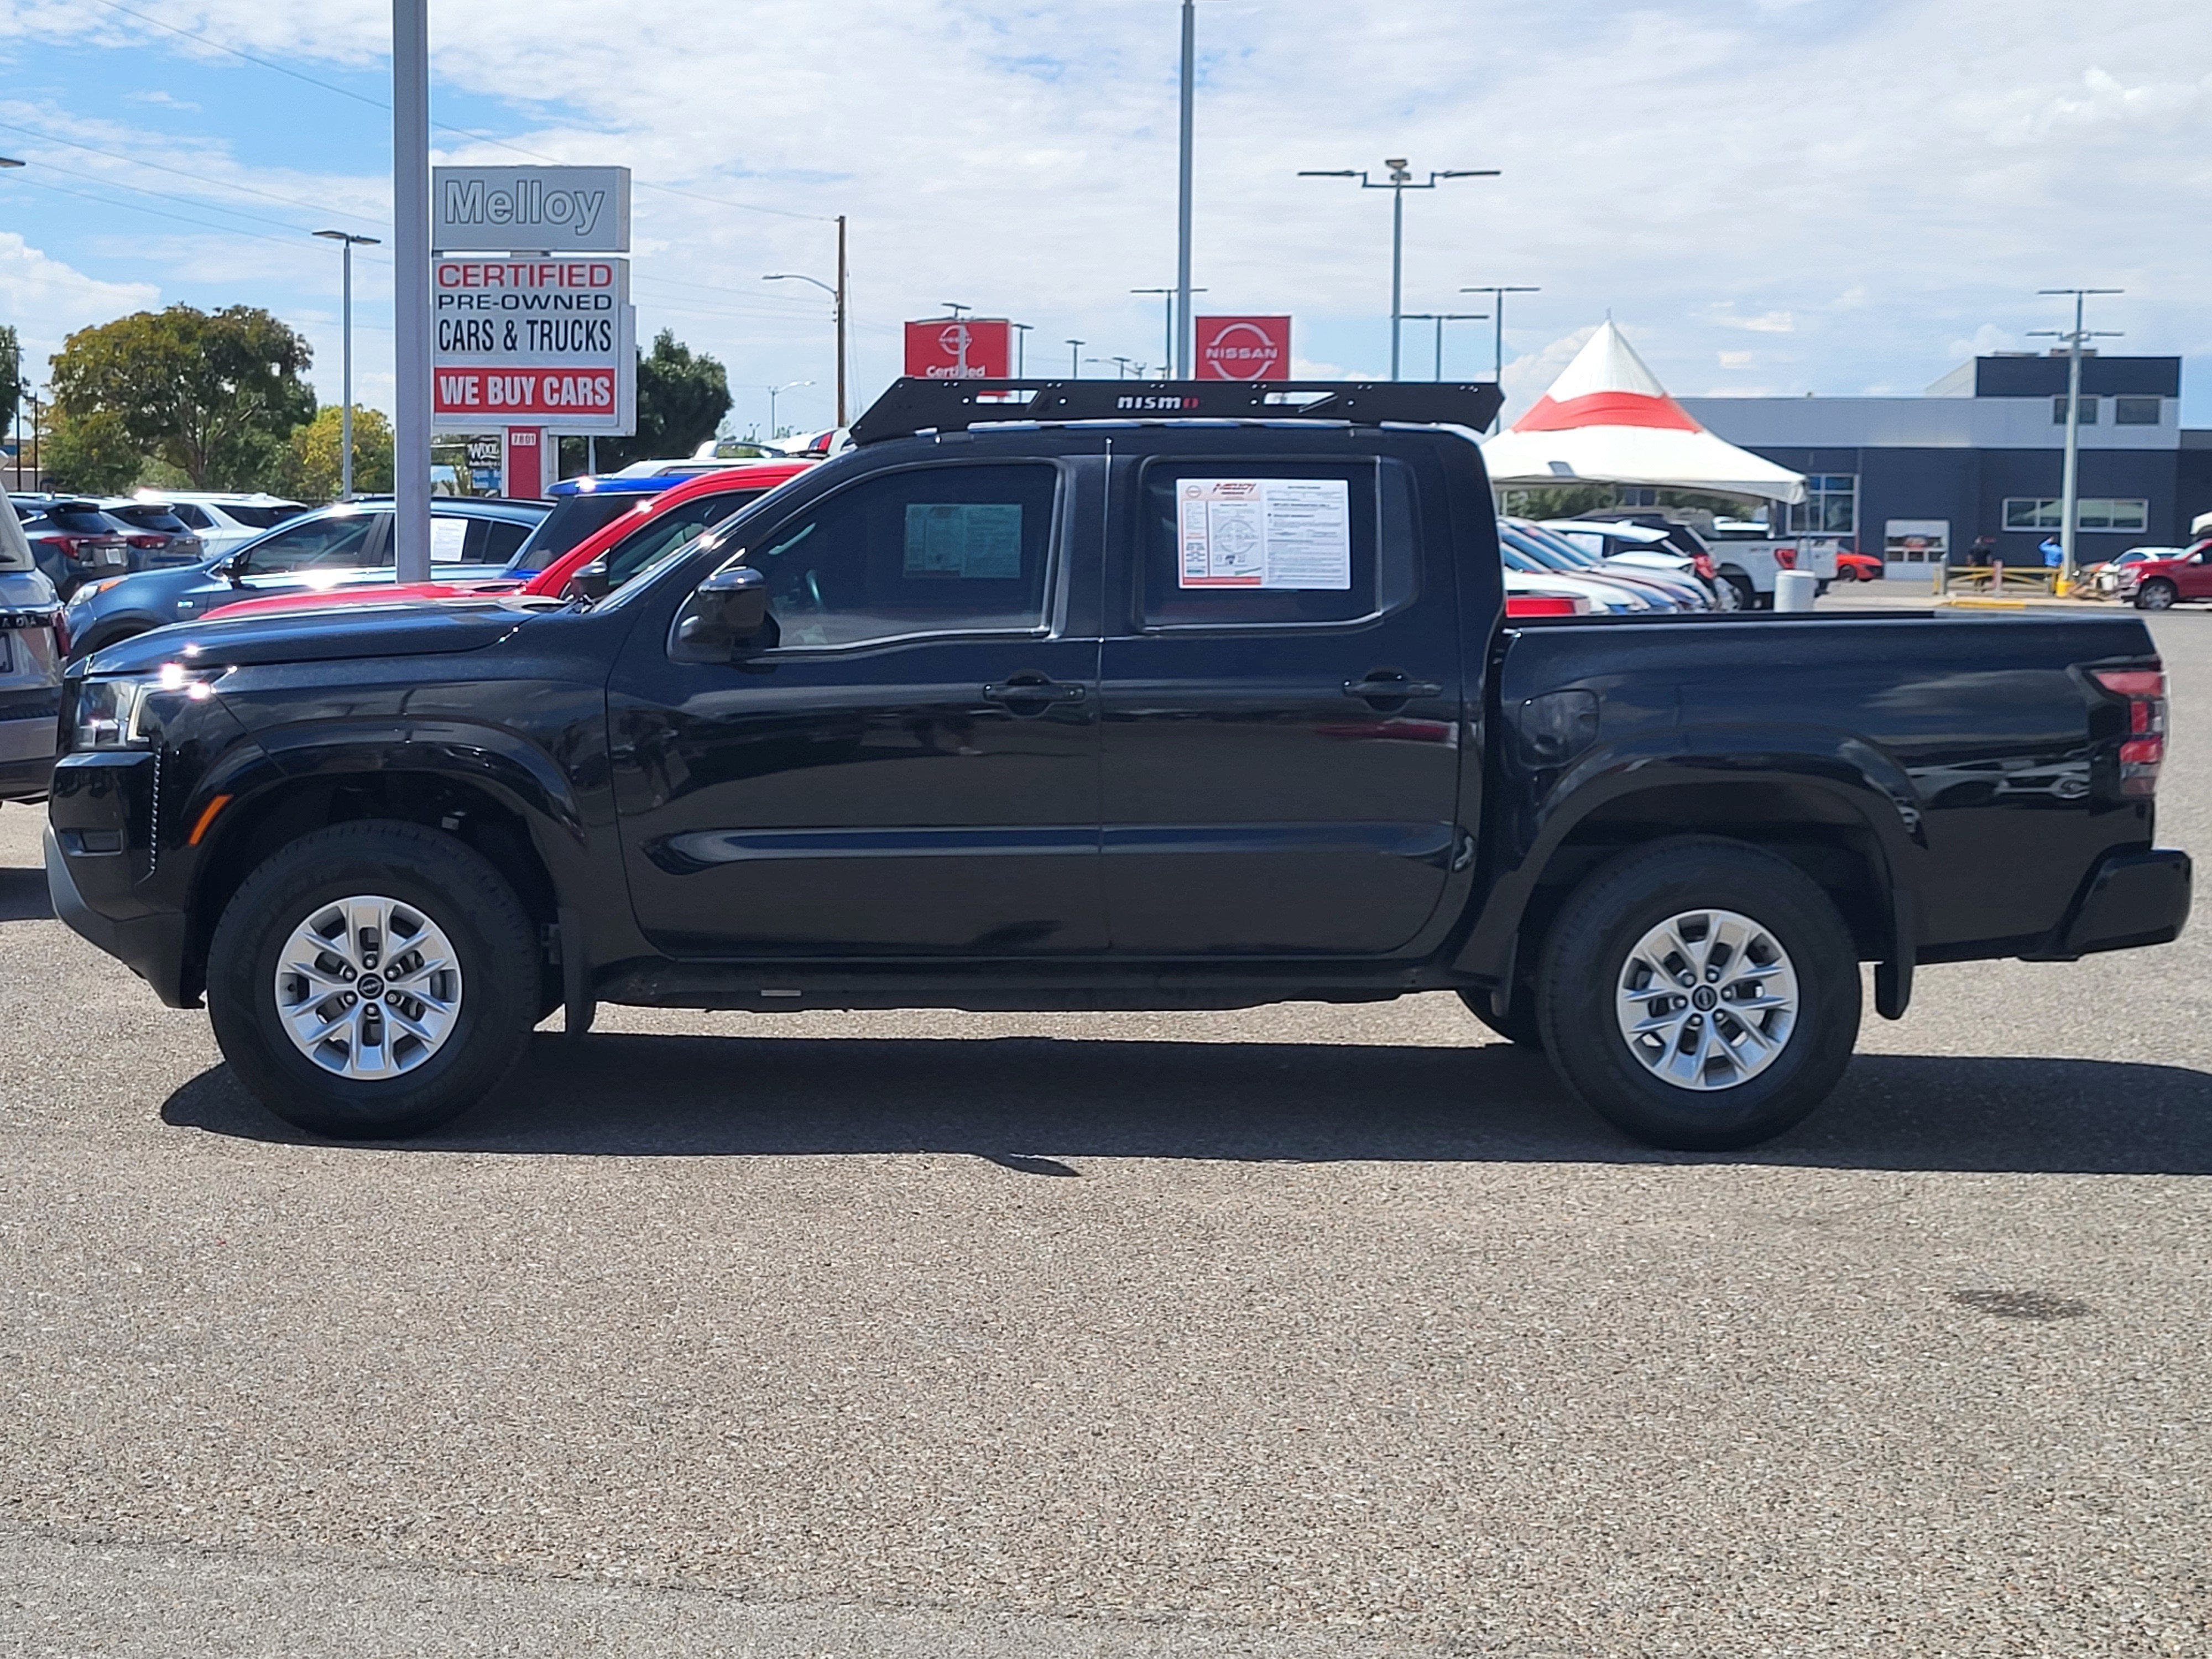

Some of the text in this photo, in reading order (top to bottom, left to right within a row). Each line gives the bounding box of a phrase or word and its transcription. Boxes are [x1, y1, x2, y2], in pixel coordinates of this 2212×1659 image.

[445, 180, 605, 236] Melloy
[439, 264, 612, 287] CERTIFIED
[439, 295, 612, 310] PRE-OWNED
[439, 320, 612, 352] CARS & TRUCKS
[1206, 348, 1277, 359] NISSAN
[926, 365, 985, 377] Certied
[440, 377, 611, 406] WE BUY CARS
